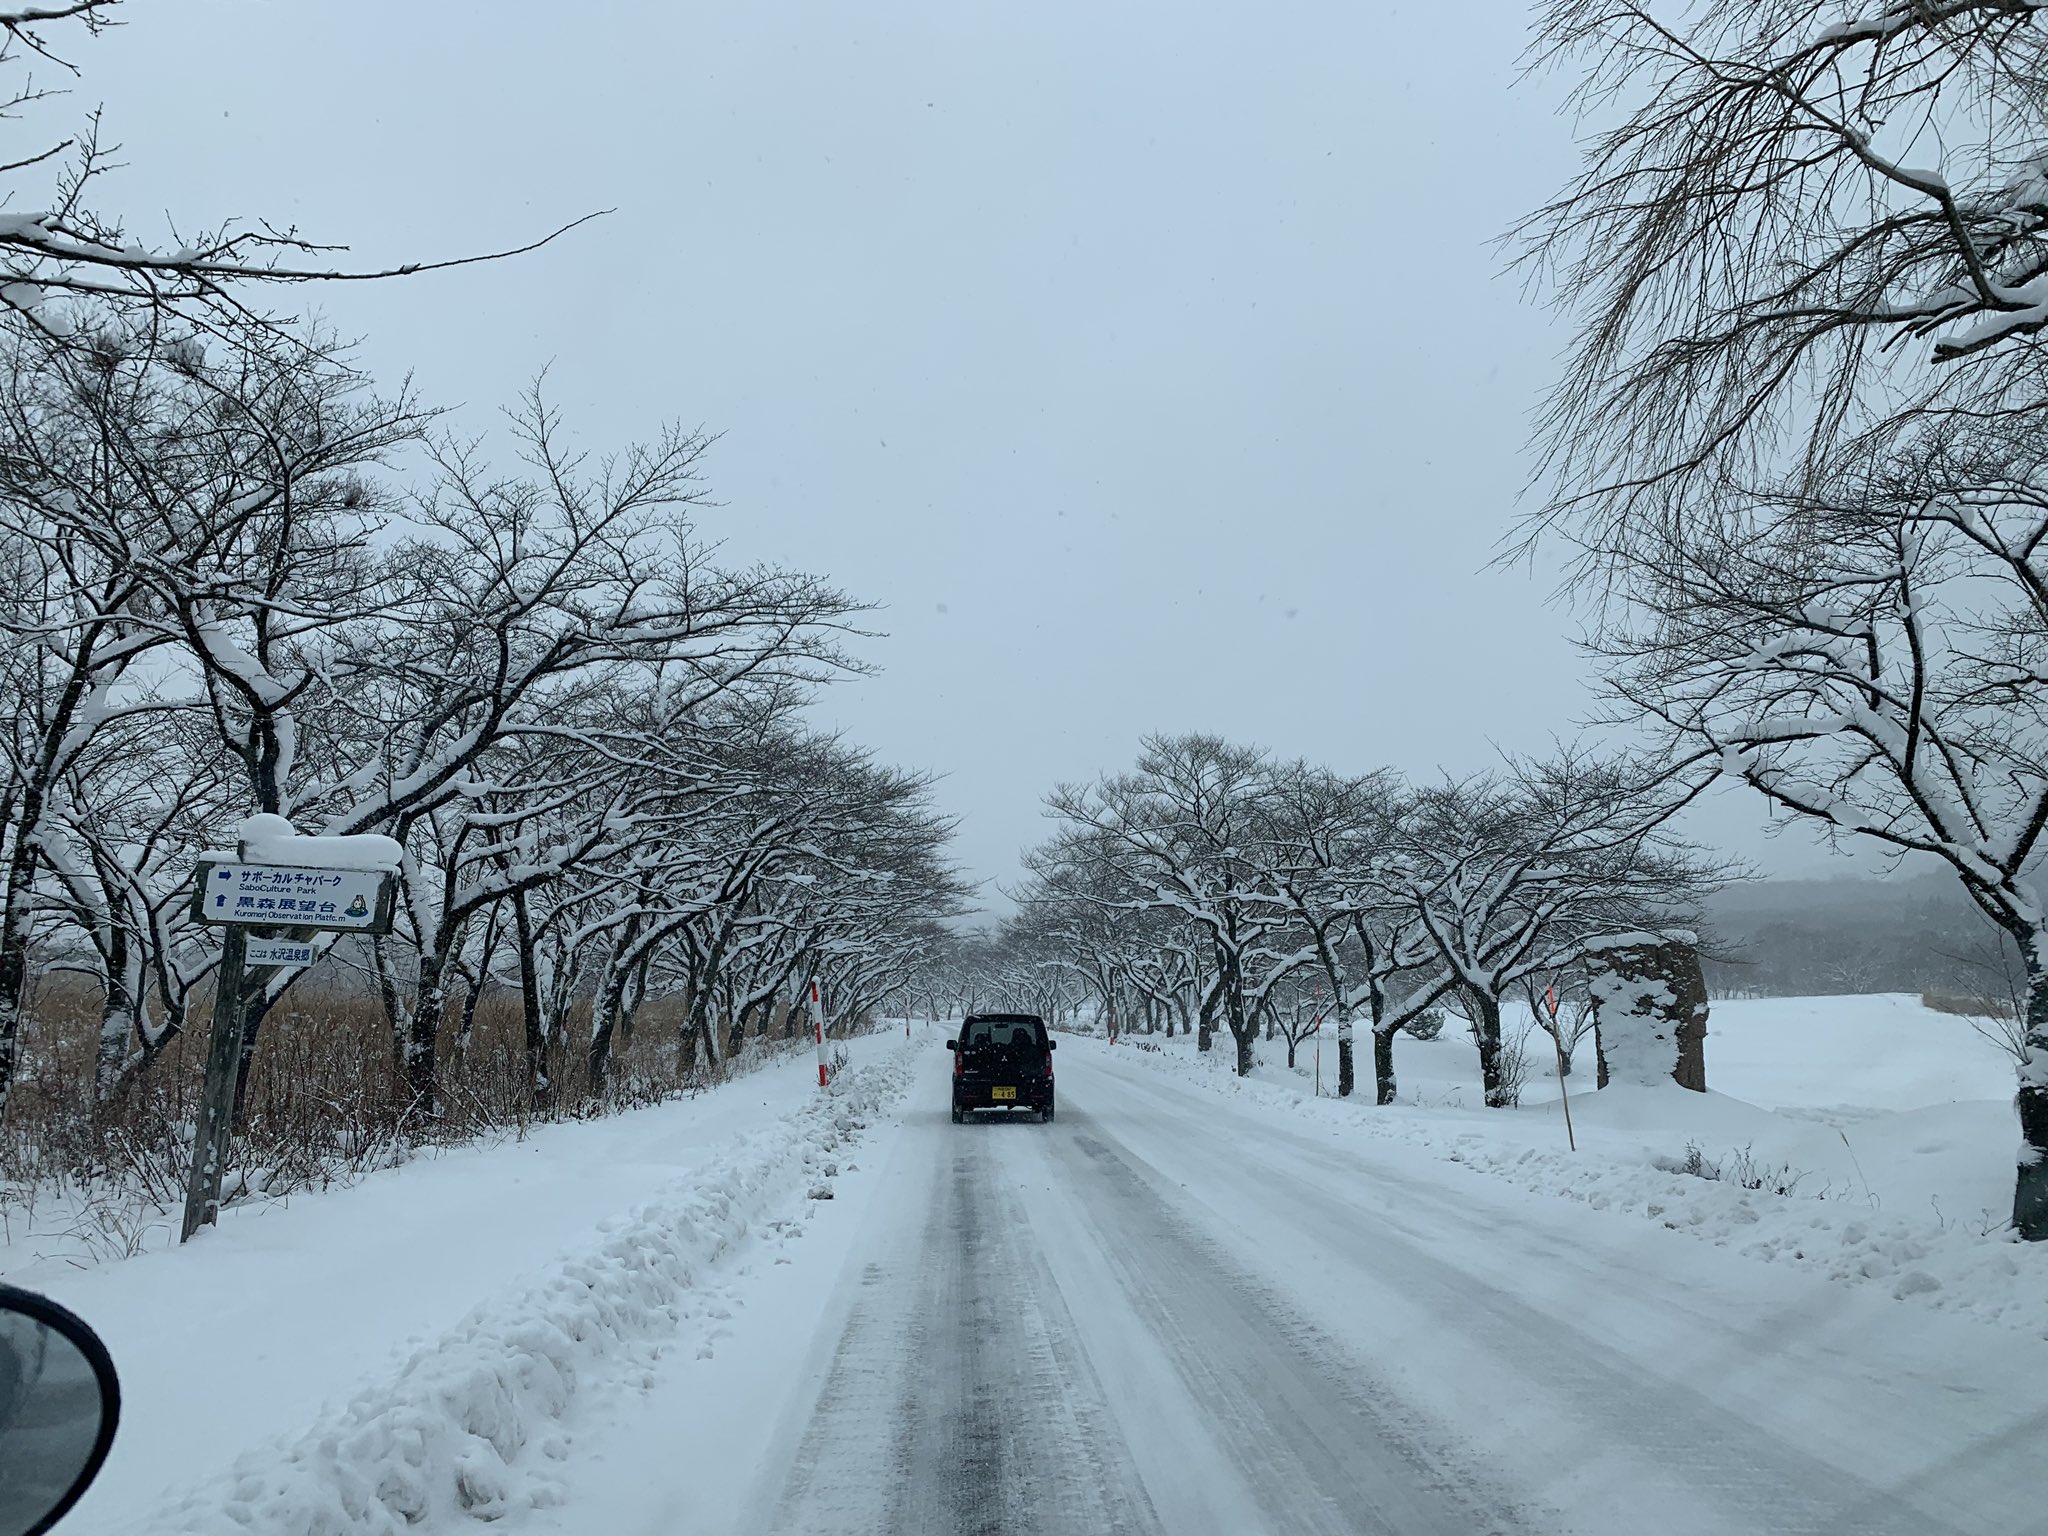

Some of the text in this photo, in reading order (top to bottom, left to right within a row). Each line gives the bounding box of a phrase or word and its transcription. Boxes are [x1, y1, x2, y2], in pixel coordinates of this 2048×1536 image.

[296, 887, 317, 895] Park
[236, 896, 337, 913] 黒森展望台
[234, 909, 267, 919] Kuromori
[268, 911, 313, 921] Observation
[249, 948, 310, 961] ここは 水沢温泉郷
